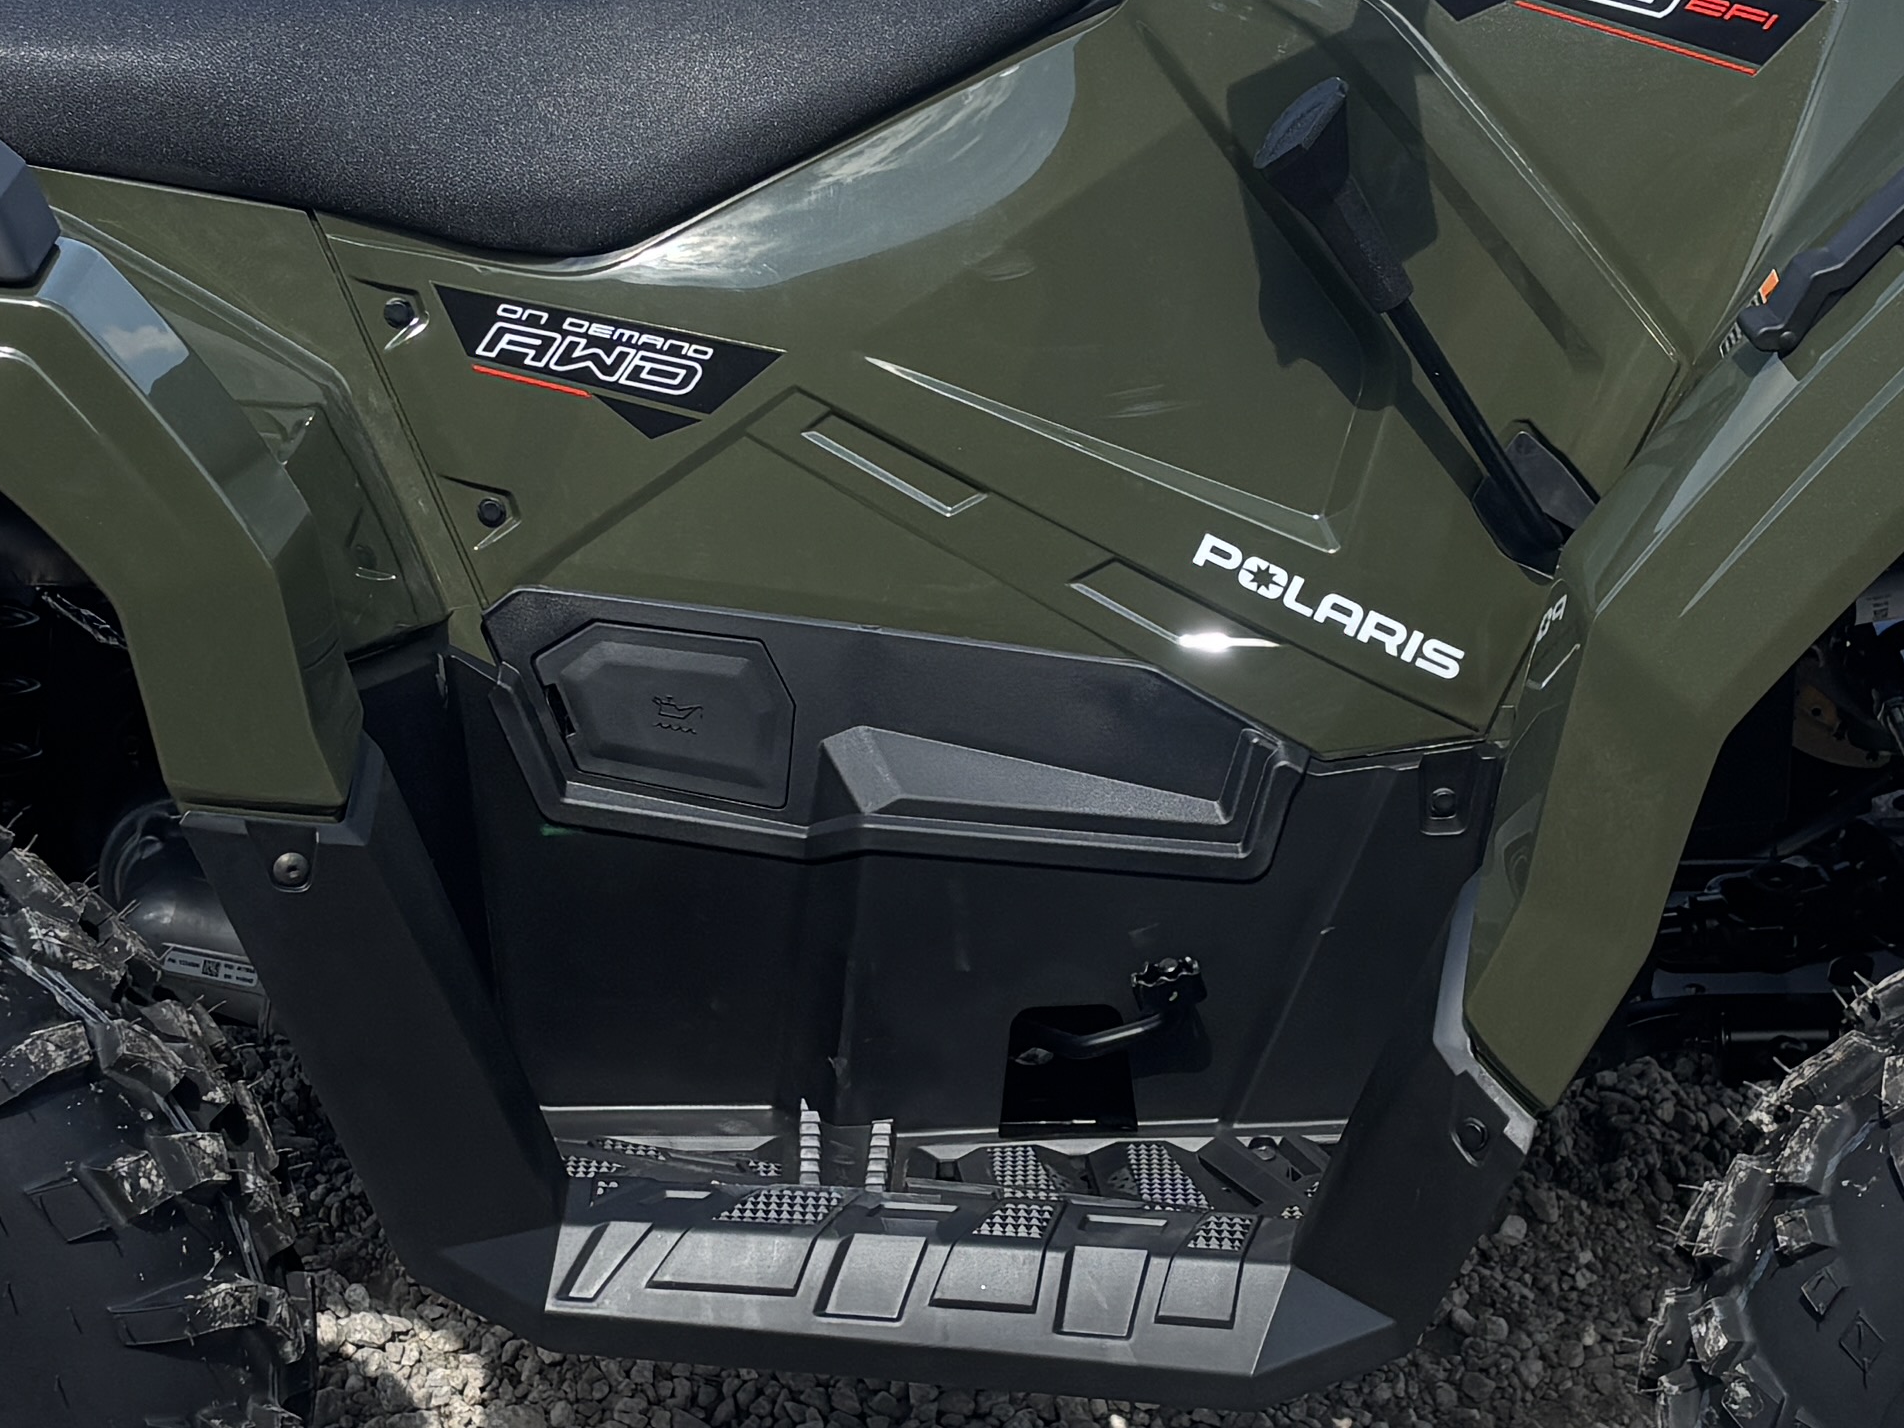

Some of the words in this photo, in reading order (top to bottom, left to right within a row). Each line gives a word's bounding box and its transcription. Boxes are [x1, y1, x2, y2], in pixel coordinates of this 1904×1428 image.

[475, 321, 703, 395] AWD
[562, 317, 714, 360] DEMAND
[1192, 533, 1465, 680] POLARIS
